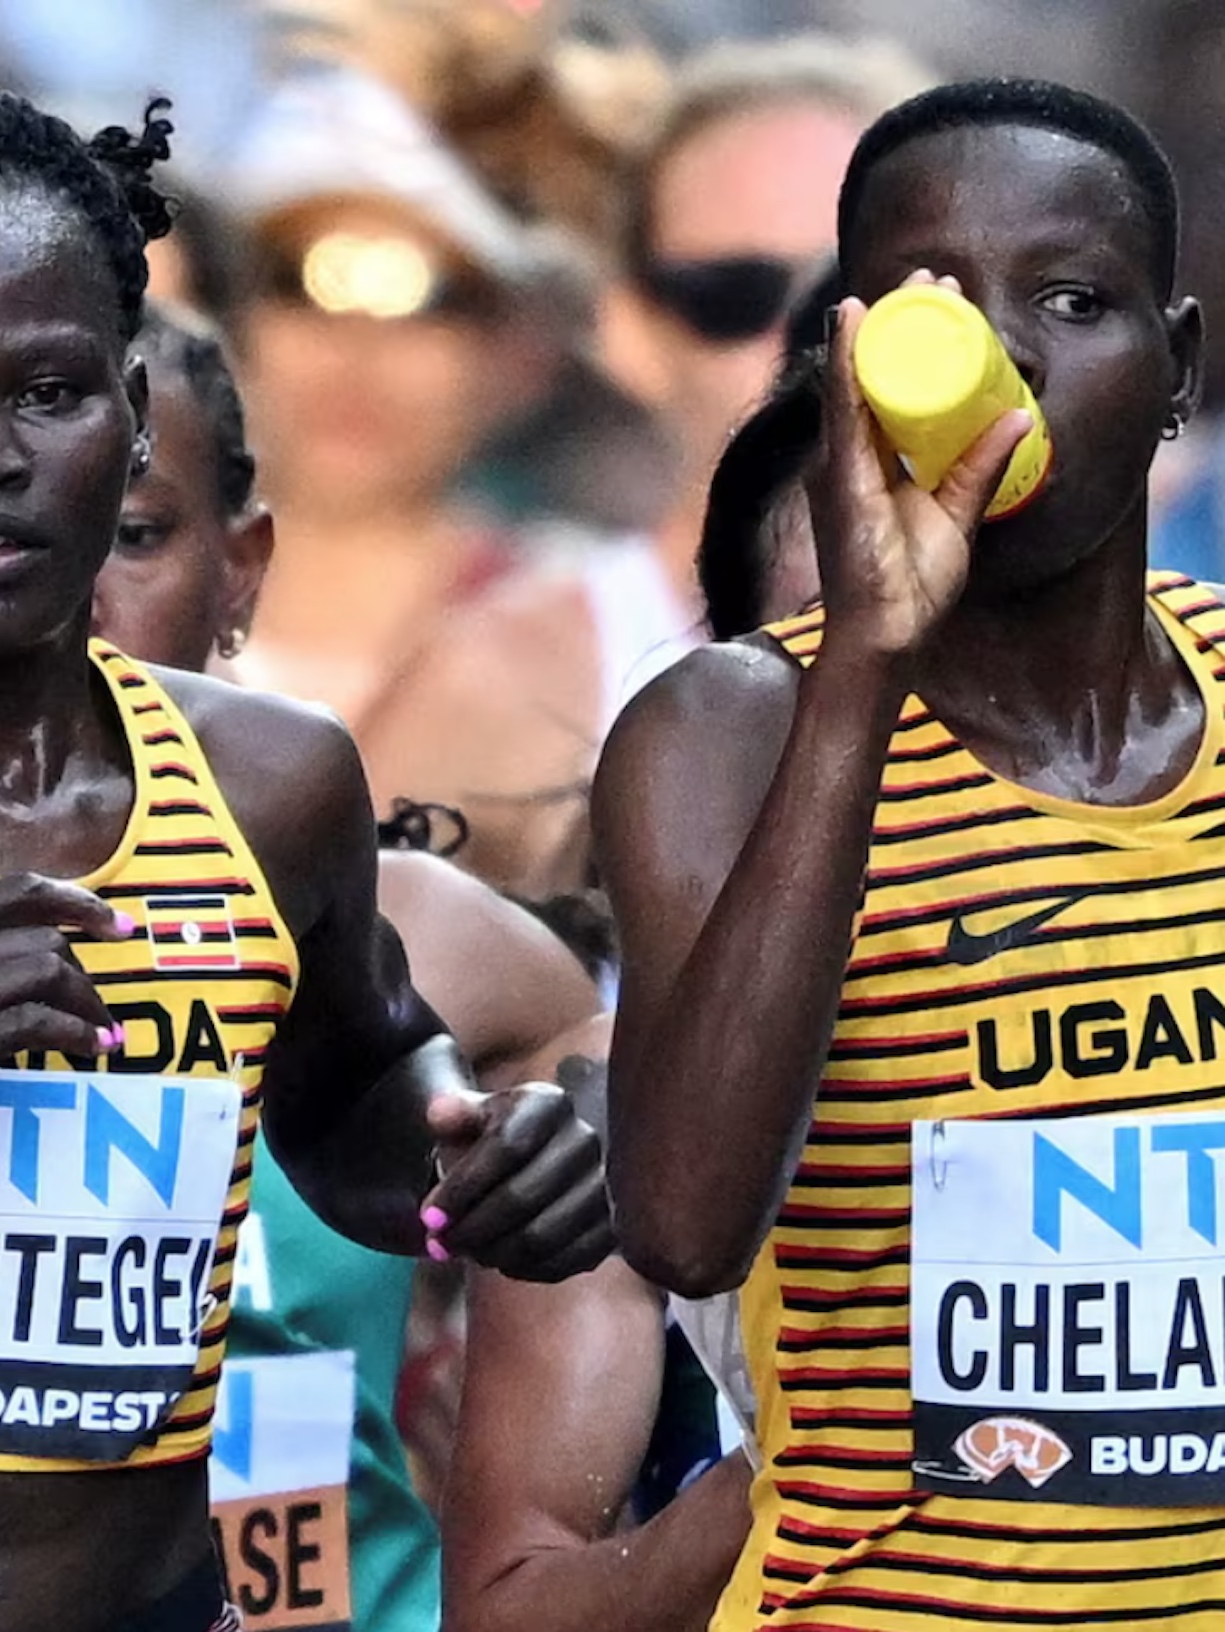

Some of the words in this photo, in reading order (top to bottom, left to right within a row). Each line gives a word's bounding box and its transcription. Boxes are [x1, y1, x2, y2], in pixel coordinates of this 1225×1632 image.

[1032, 1121, 1225, 1254] NT
[937, 1277, 1218, 1392] CHELA
[212, 1503, 323, 1617] SE
